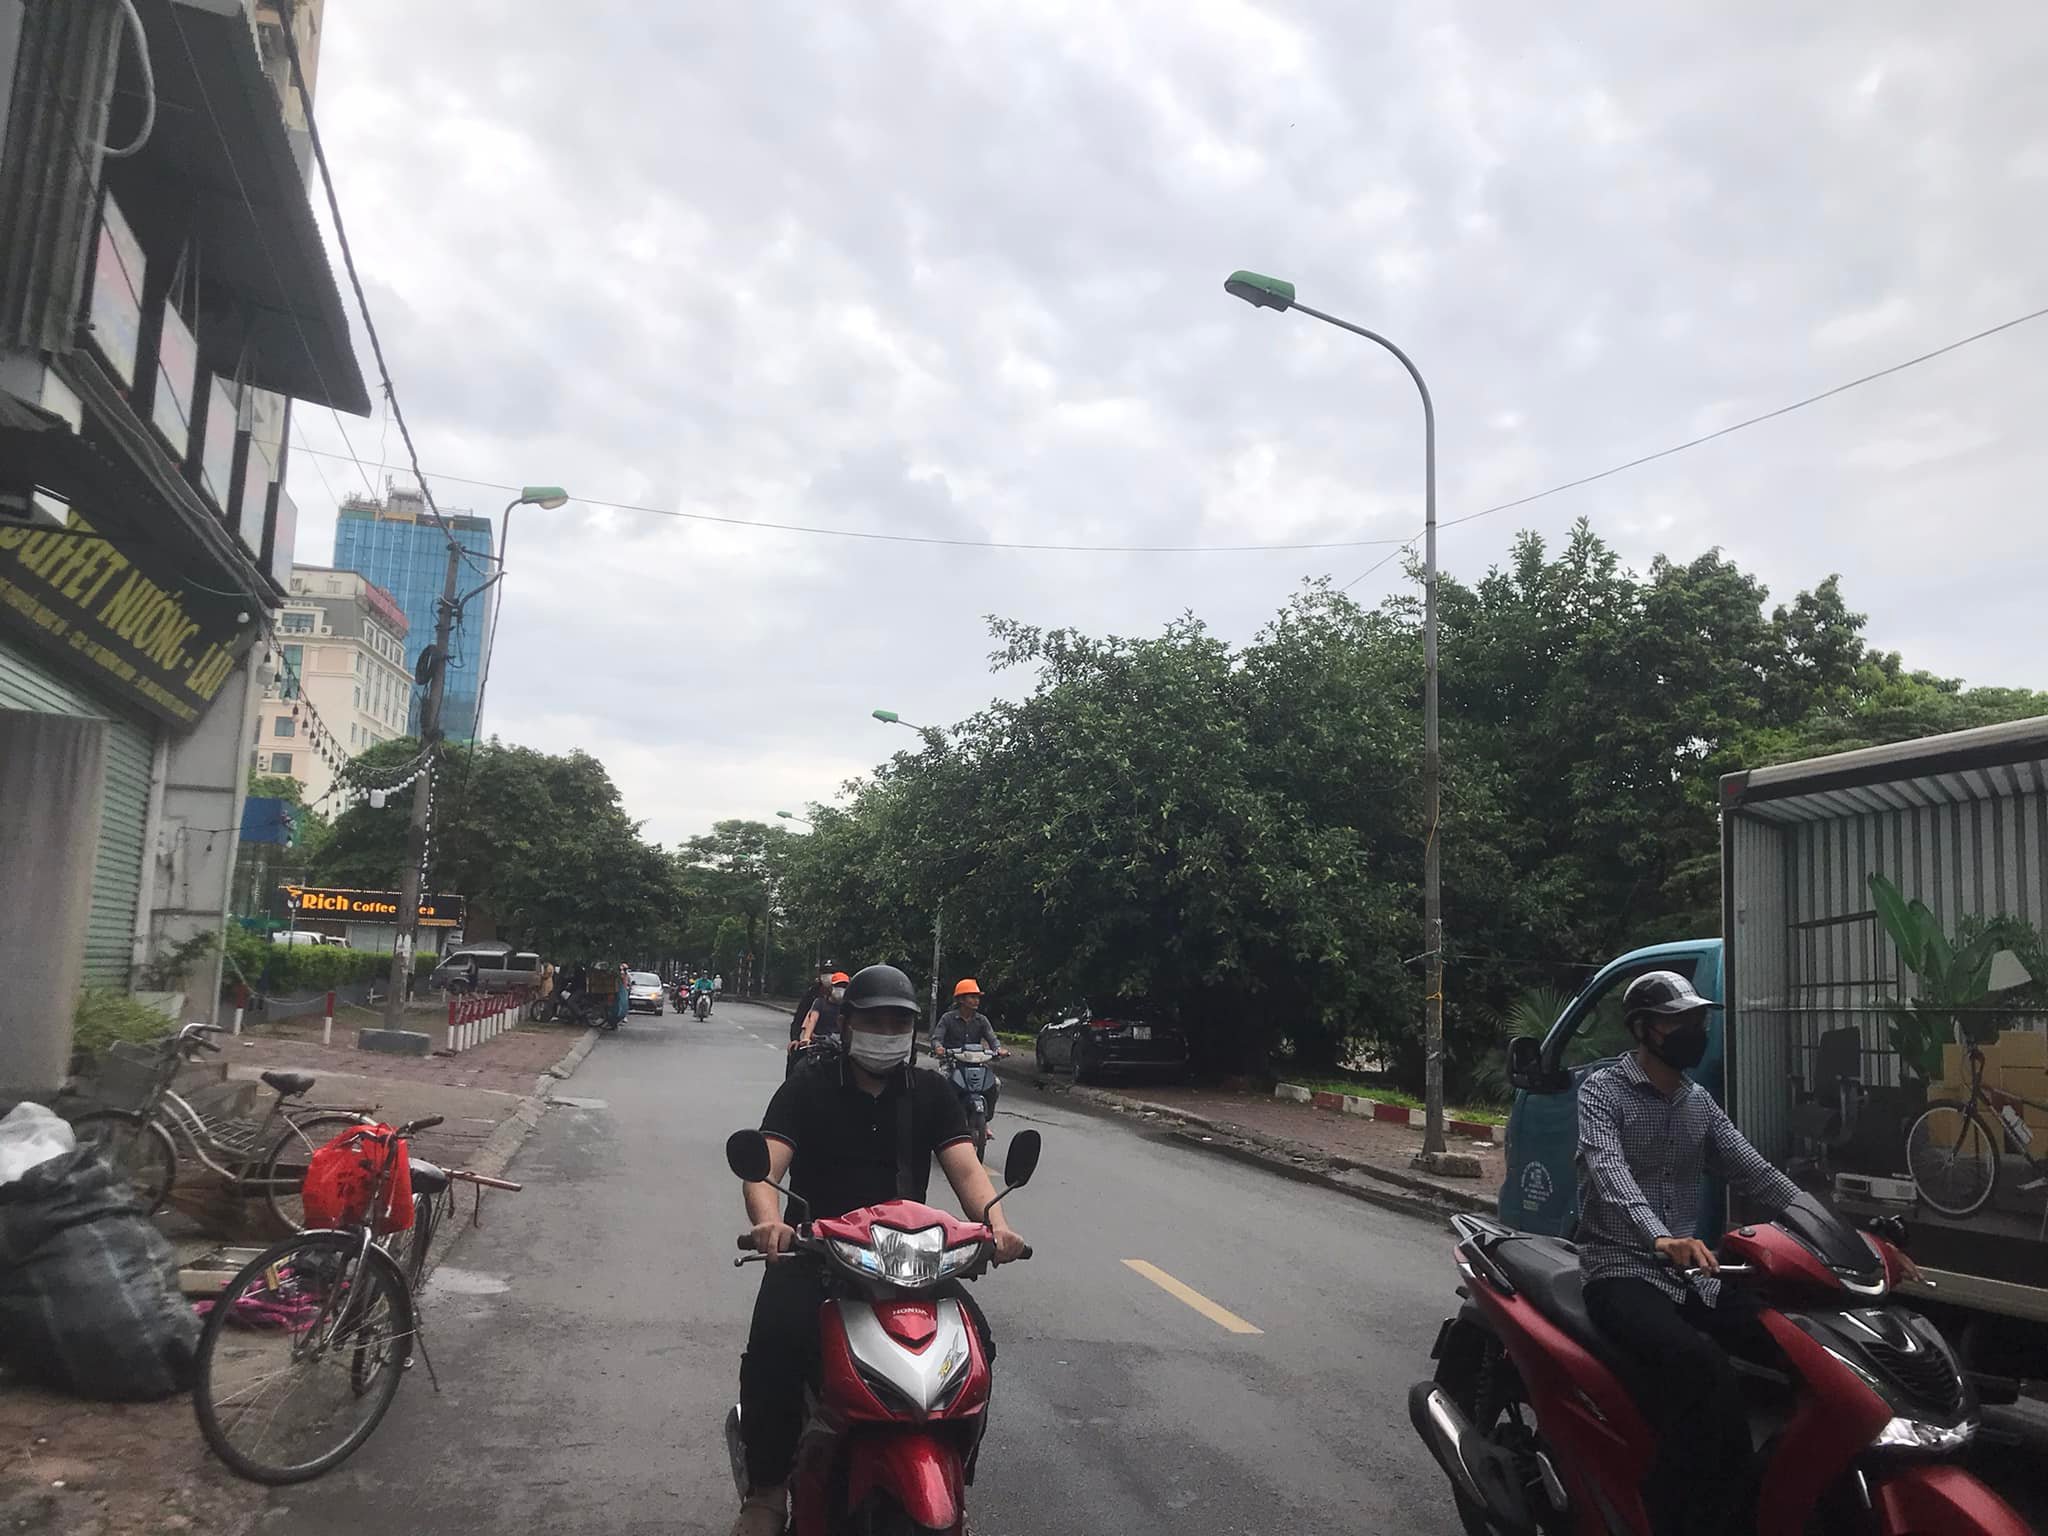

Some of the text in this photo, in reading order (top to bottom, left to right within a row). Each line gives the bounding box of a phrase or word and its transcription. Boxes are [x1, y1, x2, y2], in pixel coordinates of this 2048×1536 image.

[302, 893, 435, 915] Rich Coffee ea
[892, 1307, 928, 1316] HONDA
